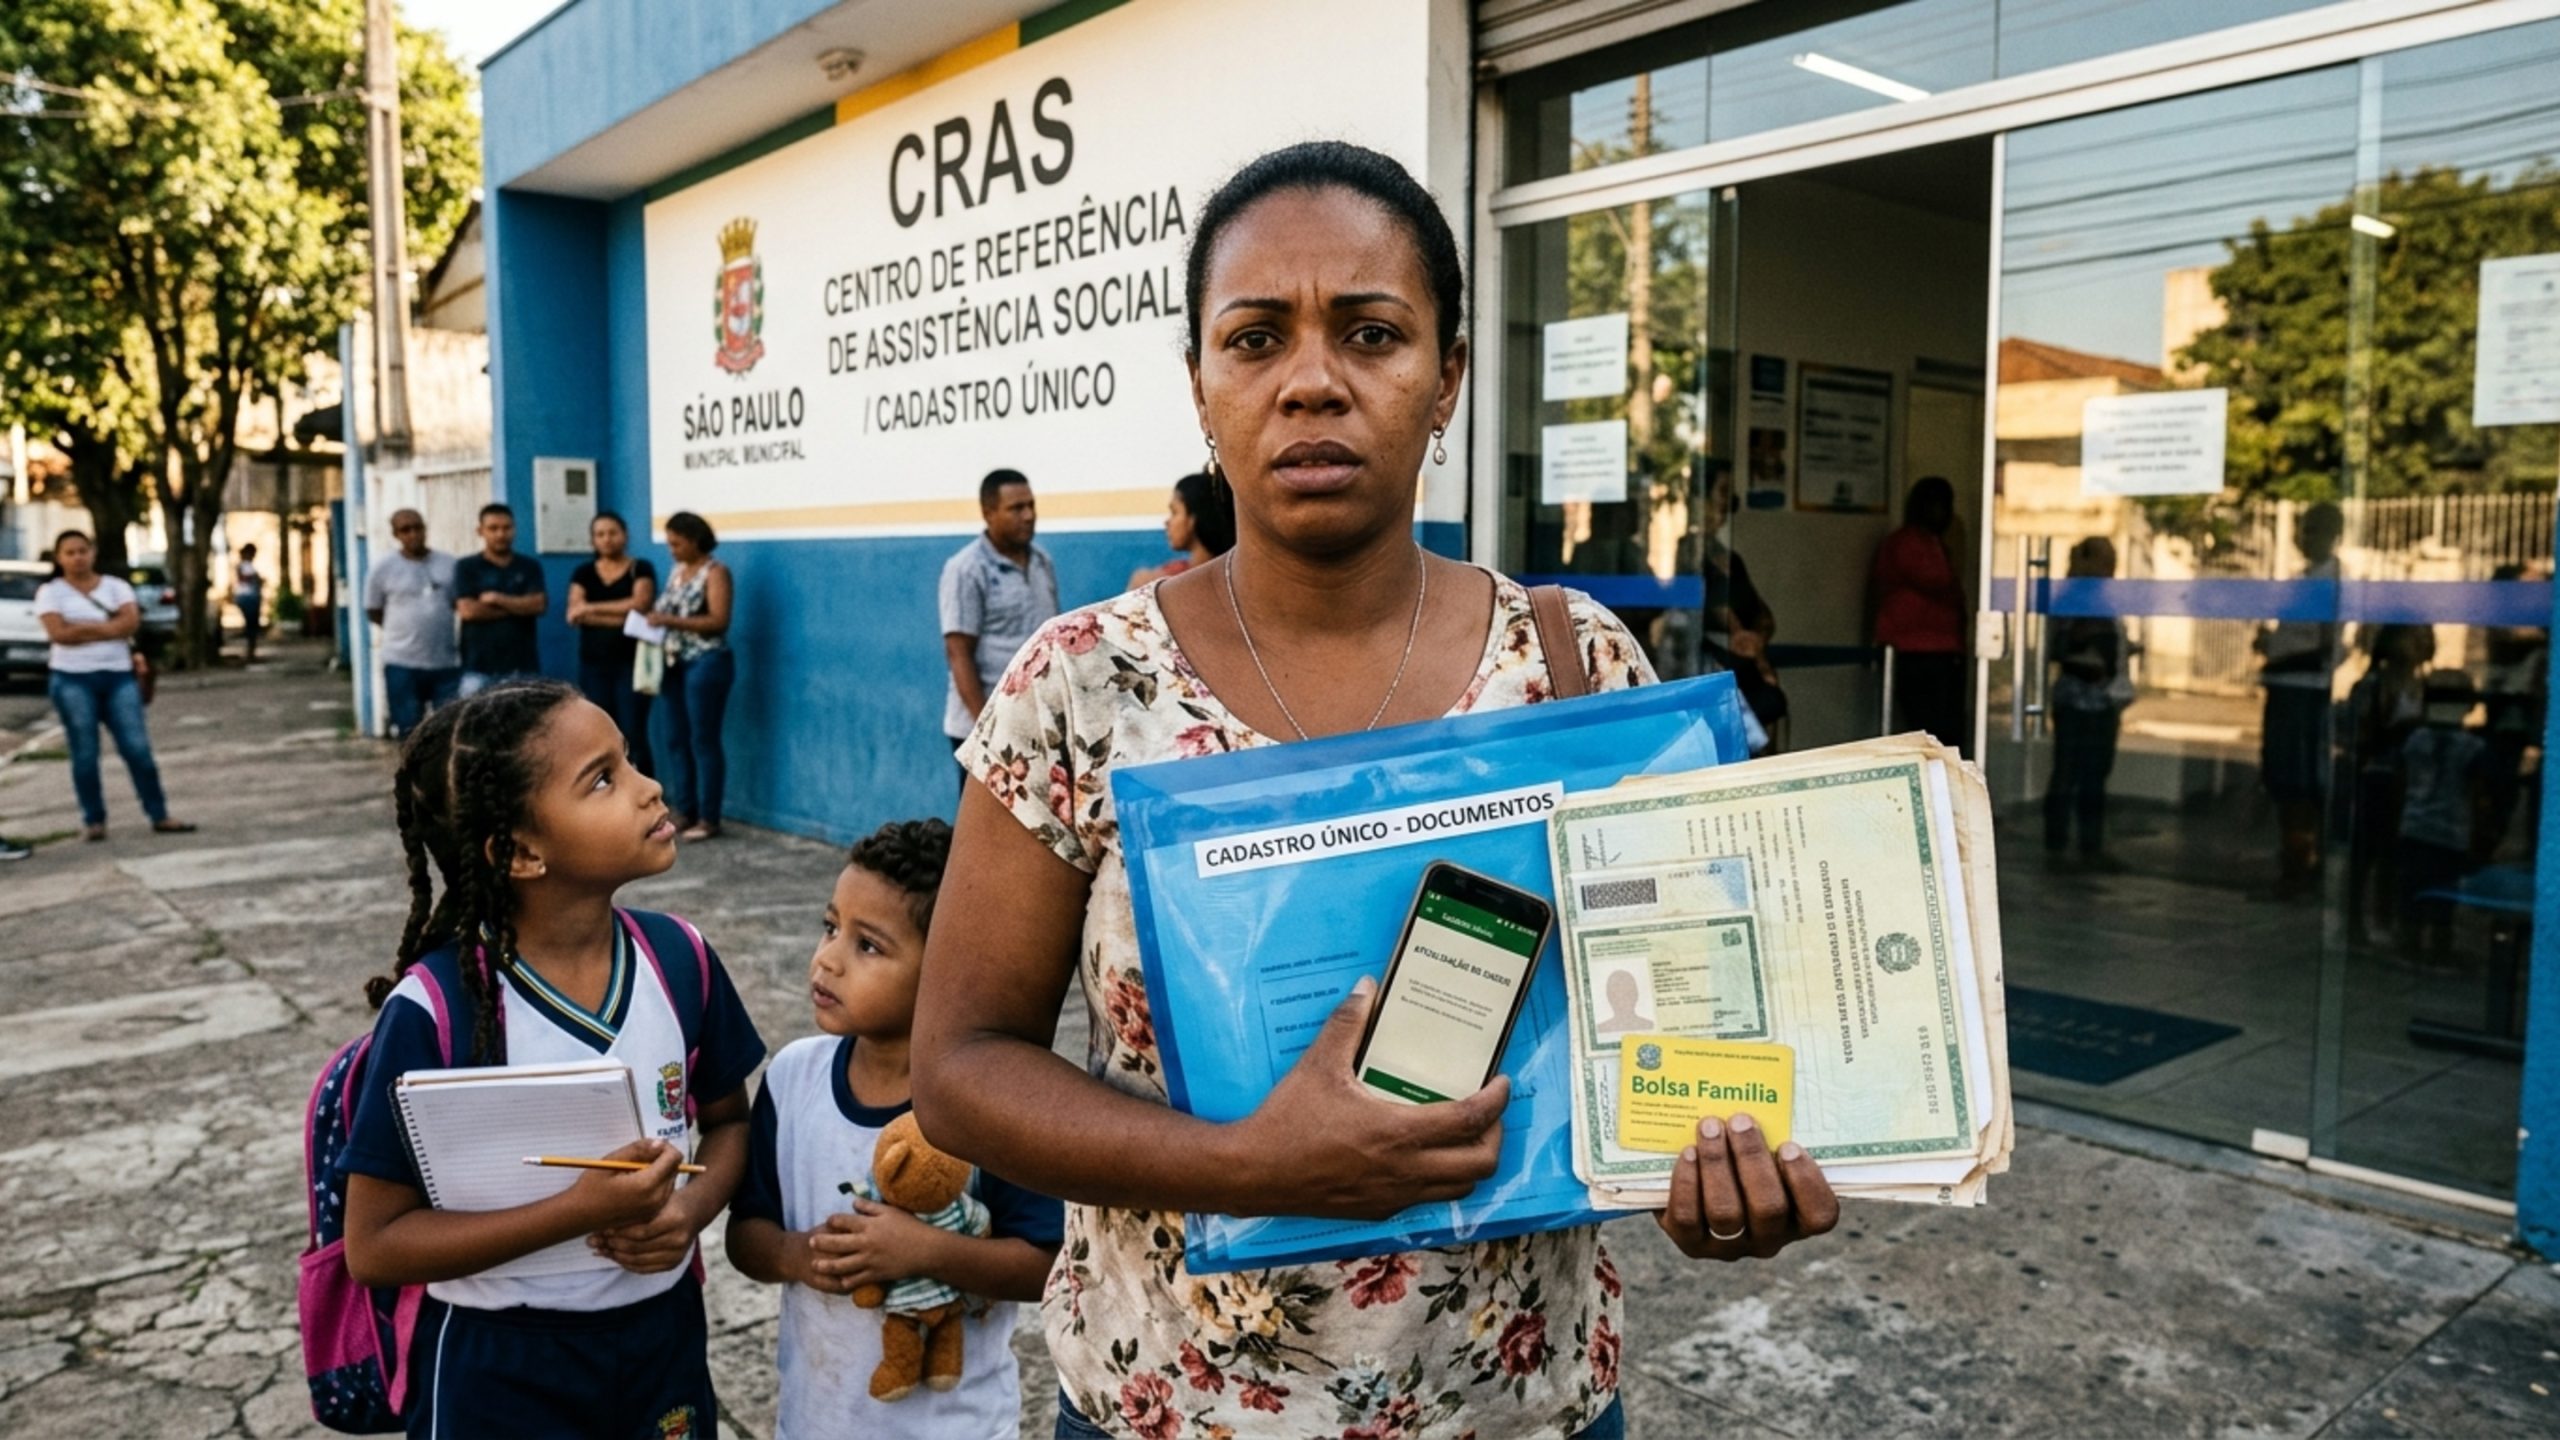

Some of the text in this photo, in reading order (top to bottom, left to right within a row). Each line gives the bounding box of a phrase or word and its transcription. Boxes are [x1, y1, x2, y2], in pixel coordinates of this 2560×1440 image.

[888, 76, 1075, 229] CRAS
[824, 185, 1187, 317] CENTRO DE REFERÊNCIA
[828, 265, 1184, 376] DE ASSISTÊNCIA SOCIAL
[684, 386, 805, 441] SÃO PAULO
[1022, 360, 1116, 416] ÚNICO
[1206, 832, 1316, 868] CADASTRO
[1321, 821, 1388, 848] ÚNICO
[1406, 792, 1555, 834] DOCUMENTOS
[1631, 1075, 1778, 1104] Bolsa Familia
